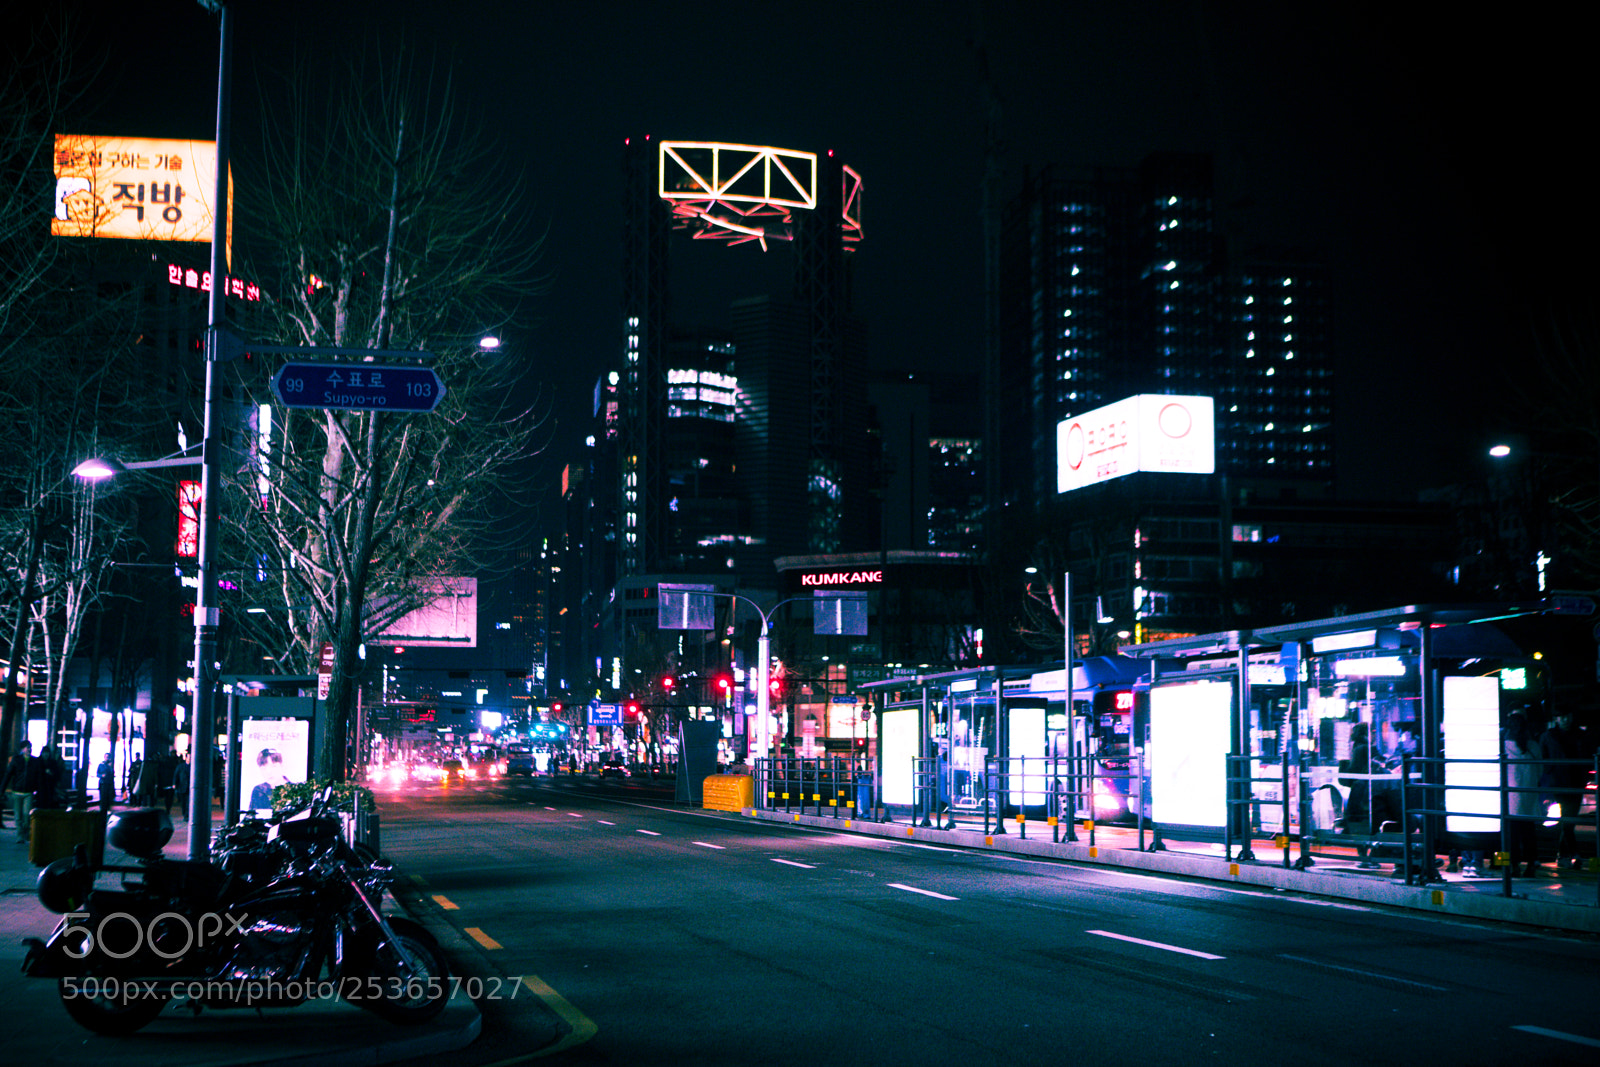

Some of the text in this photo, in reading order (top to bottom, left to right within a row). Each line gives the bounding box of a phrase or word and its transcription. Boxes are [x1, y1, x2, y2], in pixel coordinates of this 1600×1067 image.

[106, 151, 150, 170] 구하는
[154, 153, 183, 171] 기술
[112, 181, 186, 223] 직방
[285, 378, 304, 393] 99
[326, 370, 386, 388] 수표로
[406, 382, 432, 397] 103
[323, 391, 387, 406] Supyo-ro
[801, 570, 883, 586] KUMKANG
